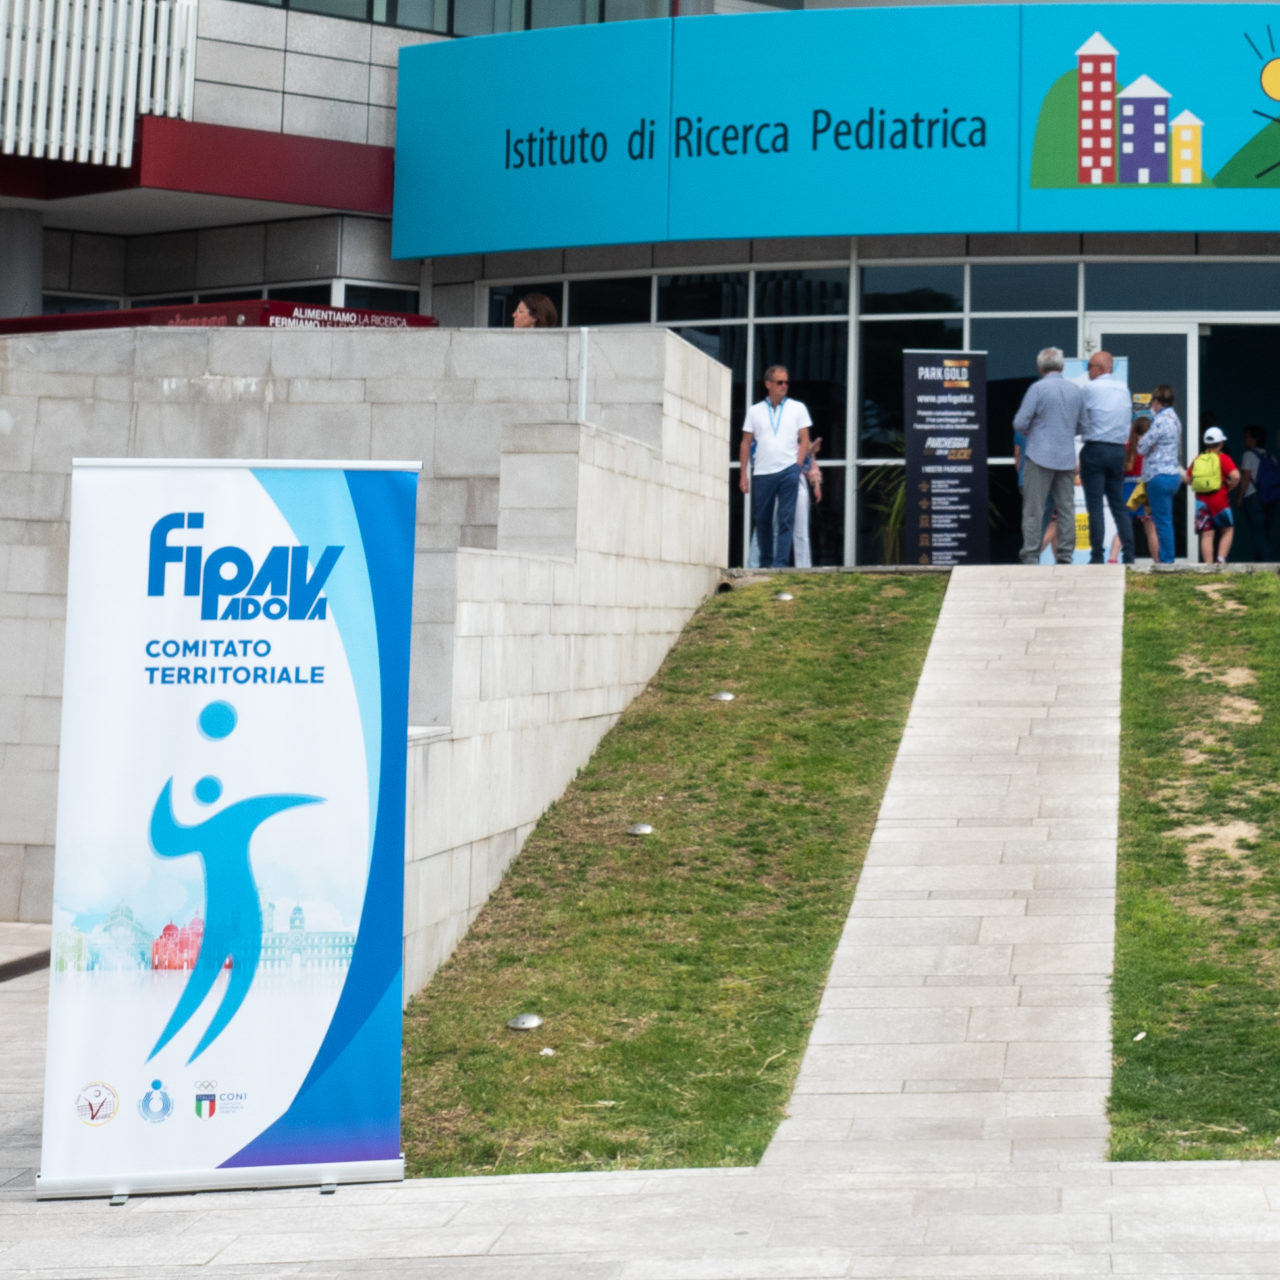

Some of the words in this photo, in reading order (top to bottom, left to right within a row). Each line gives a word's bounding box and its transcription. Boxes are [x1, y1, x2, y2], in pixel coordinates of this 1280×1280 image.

[505, 125, 608, 170] Istituto
[628, 118, 655, 160] di
[674, 116, 789, 158] Ricerca
[812, 107, 987, 151] Pediatrica
[292, 307, 357, 323] ALIMENTIAMO
[358, 314, 369, 324] LA
[371, 316, 408, 328] RICERCA
[918, 366, 943, 380] PARK
[944, 367, 968, 380] GOLD
[145, 639, 272, 658] COMITATO
[145, 666, 324, 685] TERRITORIALE
[219, 1092, 247, 1102] CONI
